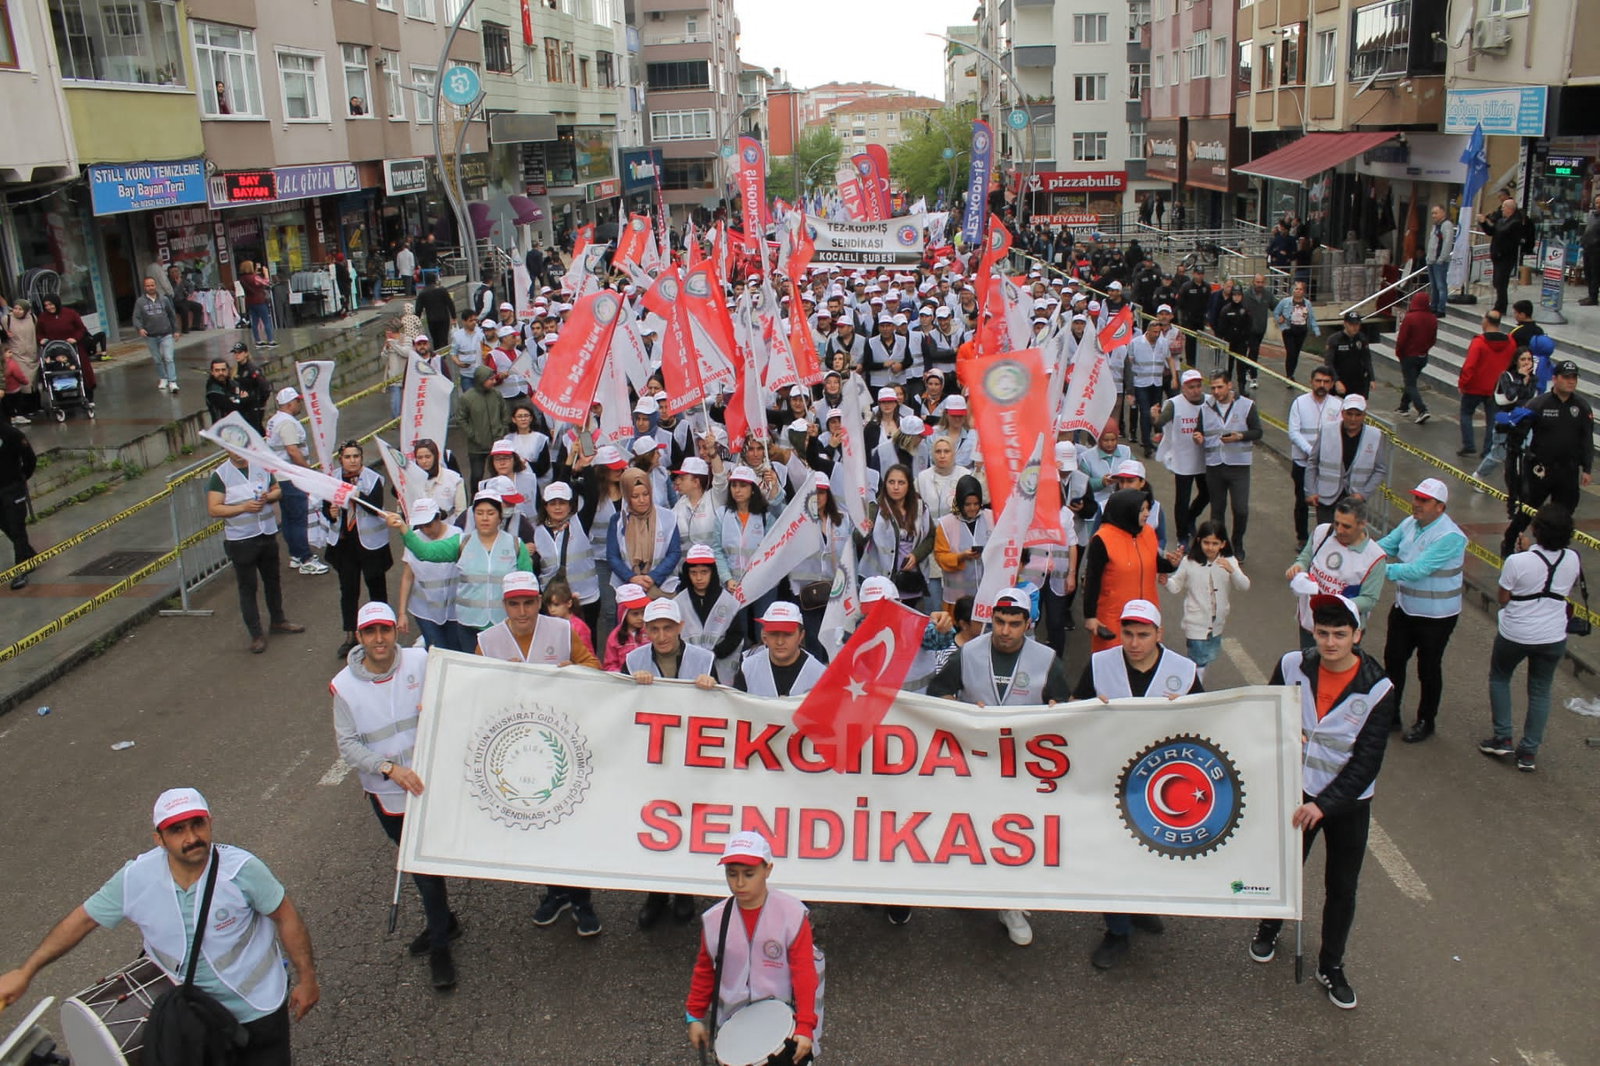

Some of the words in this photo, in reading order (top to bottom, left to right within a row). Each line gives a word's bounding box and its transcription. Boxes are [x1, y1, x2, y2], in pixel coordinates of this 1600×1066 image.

[124, 166, 151, 180] KURU
[238, 175, 260, 186] BAY
[301, 167, 331, 192] GİYİM
[392, 170, 412, 186] TOPRAK
[118, 184, 135, 199] Bay
[137, 182, 164, 198] Bayan
[165, 179, 186, 193] Terzi
[1048, 174, 1122, 190] pizzabulls
[233, 187, 269, 197] BAYAN
[827, 222, 888, 234] TEZ-KOOP-İŞ
[831, 237, 884, 249] SENDİKASI
[819, 251, 859, 262] KOCAELİ
[862, 251, 896, 264] ŞUBESİ
[19, 634, 40, 651] KAZA
[39, 624, 56, 640] YERİ
[635, 711, 1071, 793] TEKGIDA-İŞ
[1136, 747, 1224, 781] TÜRK-İŞ
[500, 805, 546, 821] SENDİKASI
[636, 797, 1061, 868] SENDİKASI
[1152, 825, 1210, 844] 1952
